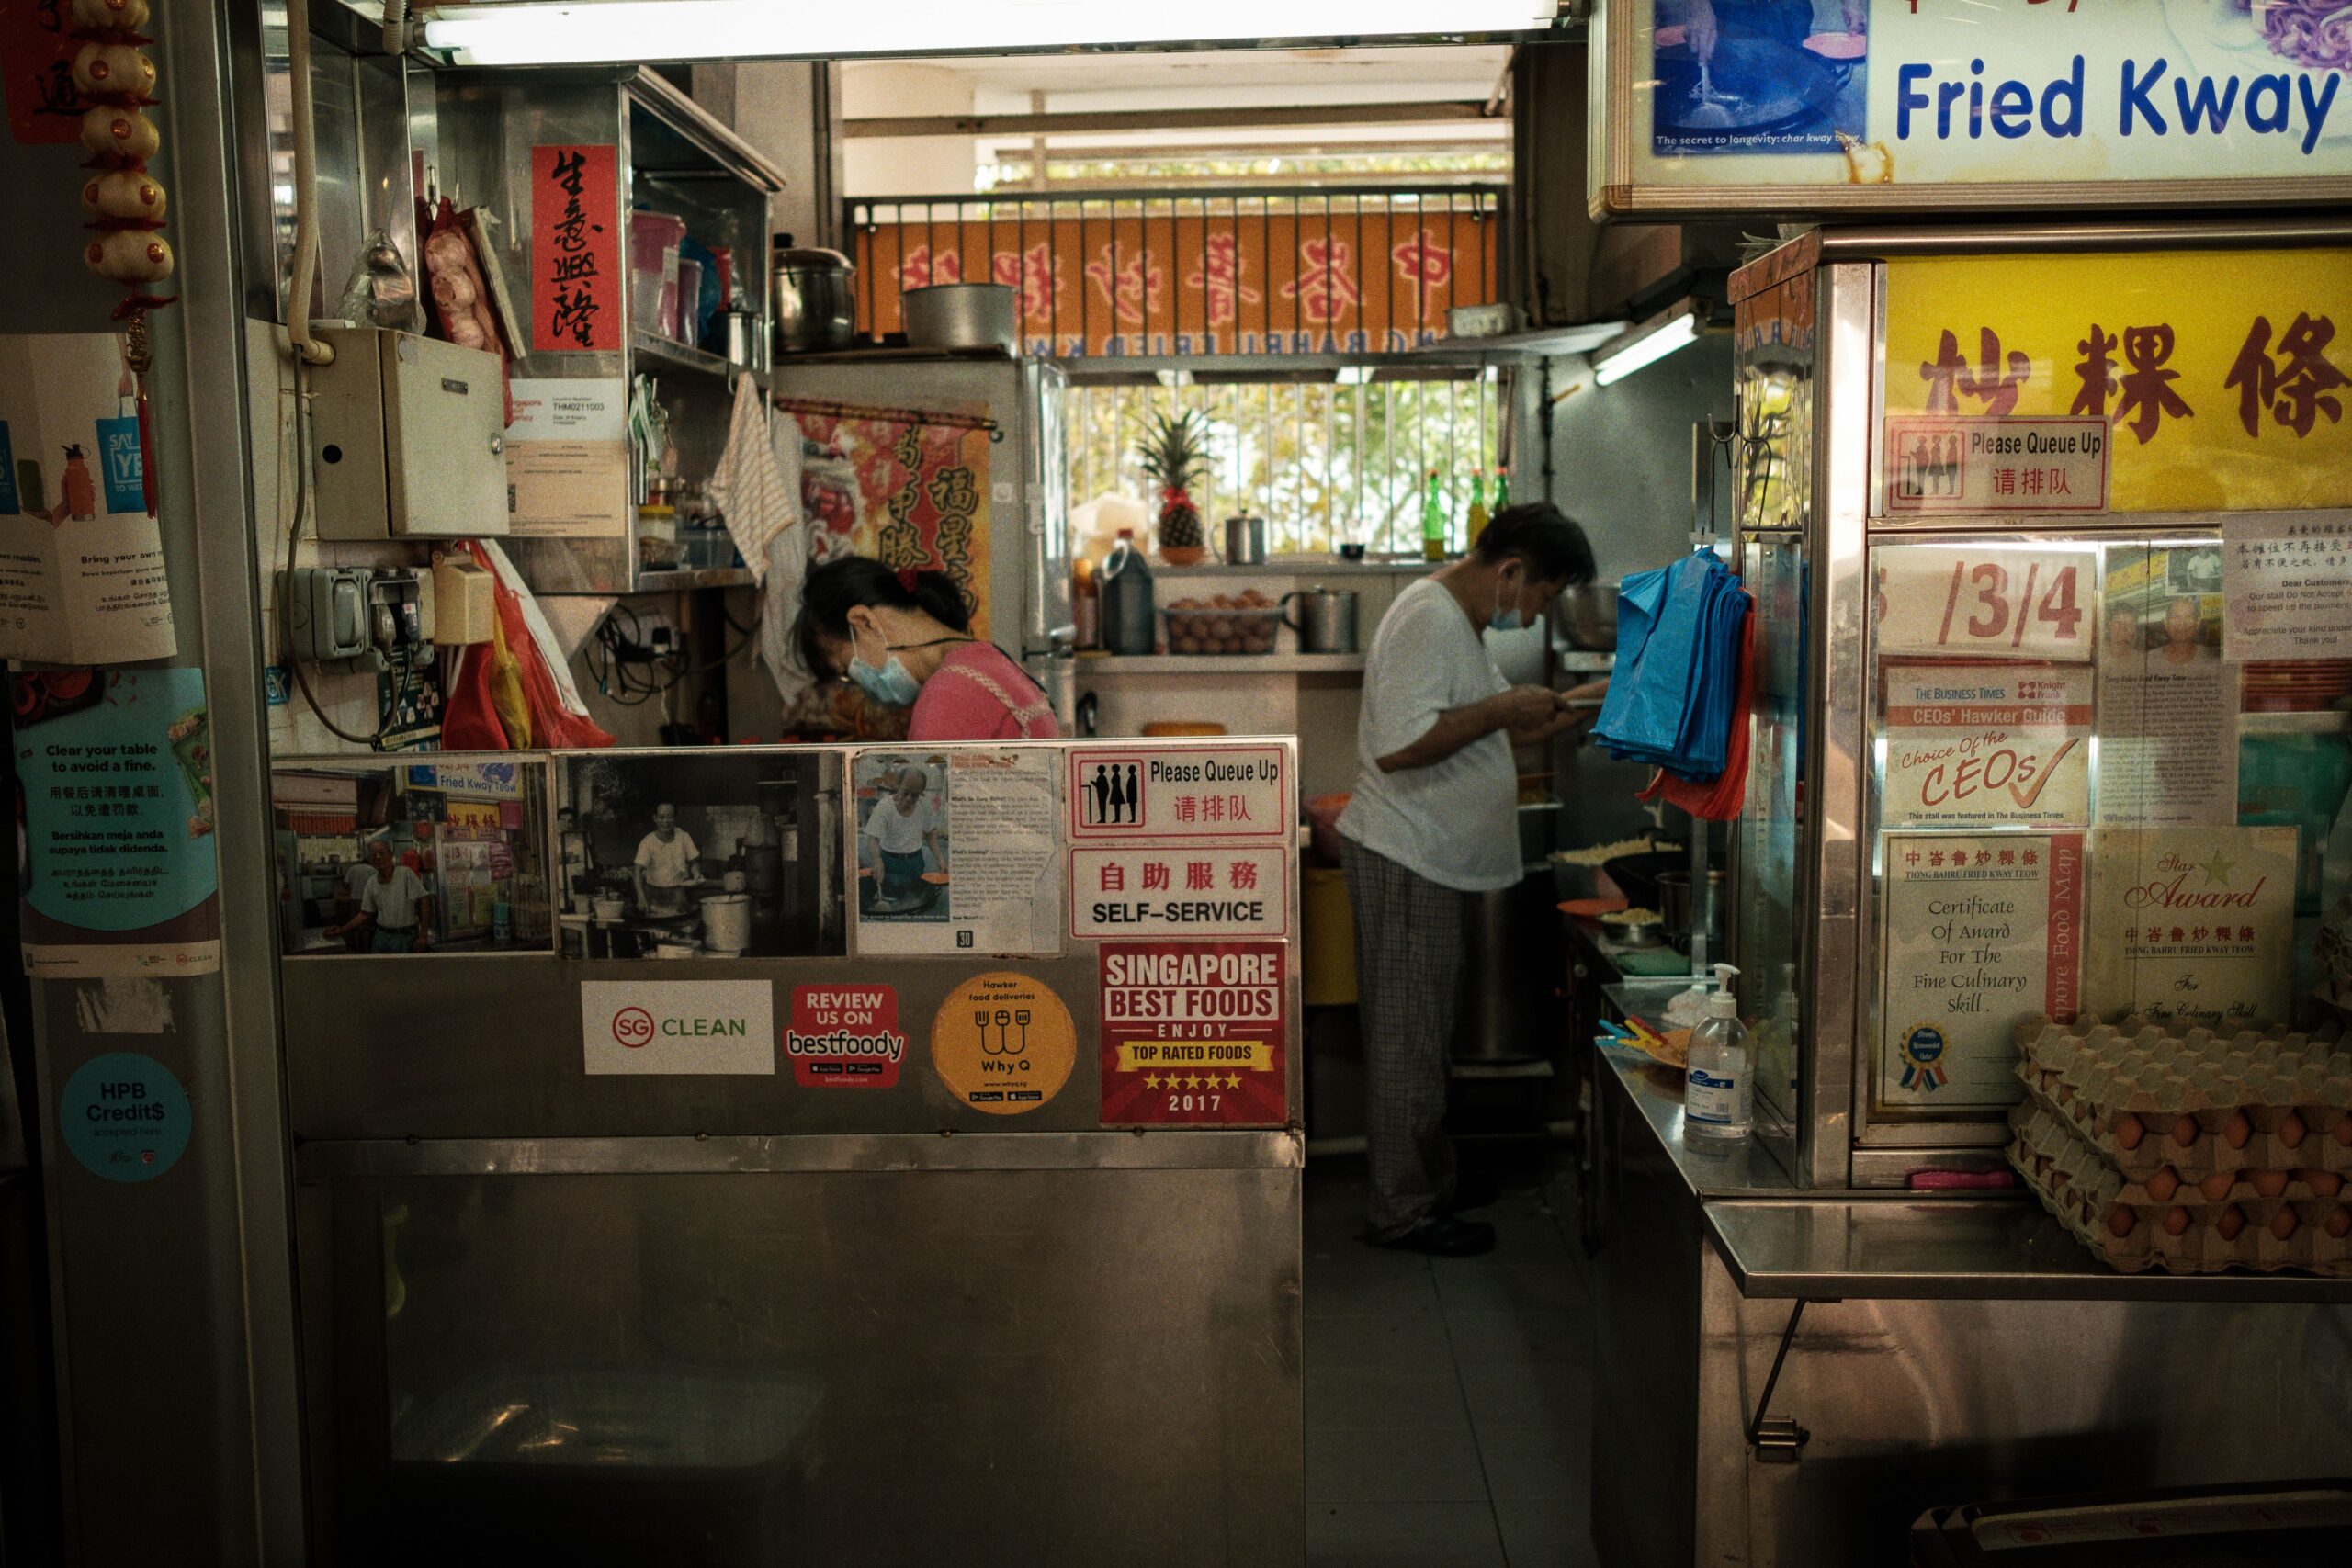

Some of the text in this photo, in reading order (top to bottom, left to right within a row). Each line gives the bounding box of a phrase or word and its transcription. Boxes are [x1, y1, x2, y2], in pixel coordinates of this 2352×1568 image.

[1896, 55, 2341, 155] Fried Kway
[1657, 133, 1833, 147] The secret to longevity: char kway
[110, 434, 133, 449] SAY
[1972, 432, 2101, 459] Please Queue Up
[117, 450, 142, 477] YE
[1993, 468, 2072, 495] 请排队
[81, 556, 110, 564] Bring
[114, 553, 136, 563] your
[2282, 580, 2301, 588] Dear
[2249, 592, 2265, 601] Our
[2287, 591, 2298, 599] Do
[2301, 591, 2315, 599] Not
[2318, 590, 2344, 599] Accept
[2258, 604, 2283, 614] speed
[2286, 604, 2297, 613] up
[2299, 603, 2312, 611] the
[2314, 602, 2350, 612] payment
[2244, 626, 2287, 636] Appreciate
[2289, 626, 2306, 635] your
[2309, 625, 2326, 633] kind
[2294, 635, 2338, 646] Thank you!
[1916, 687, 2005, 700] THE BUSINESS TIMES
[2038, 682, 2065, 691] Knight
[1961, 710, 2018, 724] Hawker
[2022, 707, 2066, 723] Guide
[46, 745, 157, 761] Clear your table
[1902, 731, 2007, 769] Choice Of the
[52, 760, 155, 773] to avoid a fine.
[1151, 760, 1278, 784] Please Queue Up
[441, 775, 516, 793] Fried Kway Teow
[1922, 749, 2036, 807] CEOs
[1174, 795, 1252, 822] 请排队
[52, 829, 164, 841] Bersihkan meja anda
[50, 844, 168, 855] supaya tidak didenda.
[2157, 852, 2196, 876] Star
[1101, 862, 1259, 892] 自助服務
[1906, 870, 2038, 879] TIONG BAHRU FRIED KWAY TEOW
[2124, 873, 2267, 908] Award
[1928, 894, 2014, 919] Certificate
[2052, 847, 2077, 958] Food Map
[1092, 901, 1264, 923] SELF-SERVICE
[959, 932, 970, 946] 30
[1931, 919, 2010, 944] Of Award
[188, 954, 213, 963] CLEAN
[1939, 943, 2001, 965] For The
[2125, 945, 2255, 955] TIONG BAHRU FRIED KWAY TEOW
[1105, 953, 1278, 987] SINGAPORE
[984, 981, 1018, 989] Hawker
[1913, 968, 2027, 992] Fine Culinary
[2174, 975, 2199, 992] For
[807, 992, 883, 1009] REVIEW
[969, 992, 1035, 1001] food deliveries
[1110, 988, 1273, 1017] BEST FOODS
[816, 1011, 872, 1025] US ON
[2226, 1000, 2258, 1019] Skill
[618, 1019, 746, 1037] SG CLEAN
[1158, 1023, 1228, 1038] ENJOY
[789, 1030, 903, 1060] bestfoody
[1132, 1045, 1252, 1060] TOP RATED FOODS
[982, 1060, 1031, 1075] Why Q
[100, 1082, 146, 1100] HPB
[1169, 1095, 1222, 1111] 2017
[87, 1102, 164, 1122] Credit$
[94, 1125, 161, 1137] accepted here
